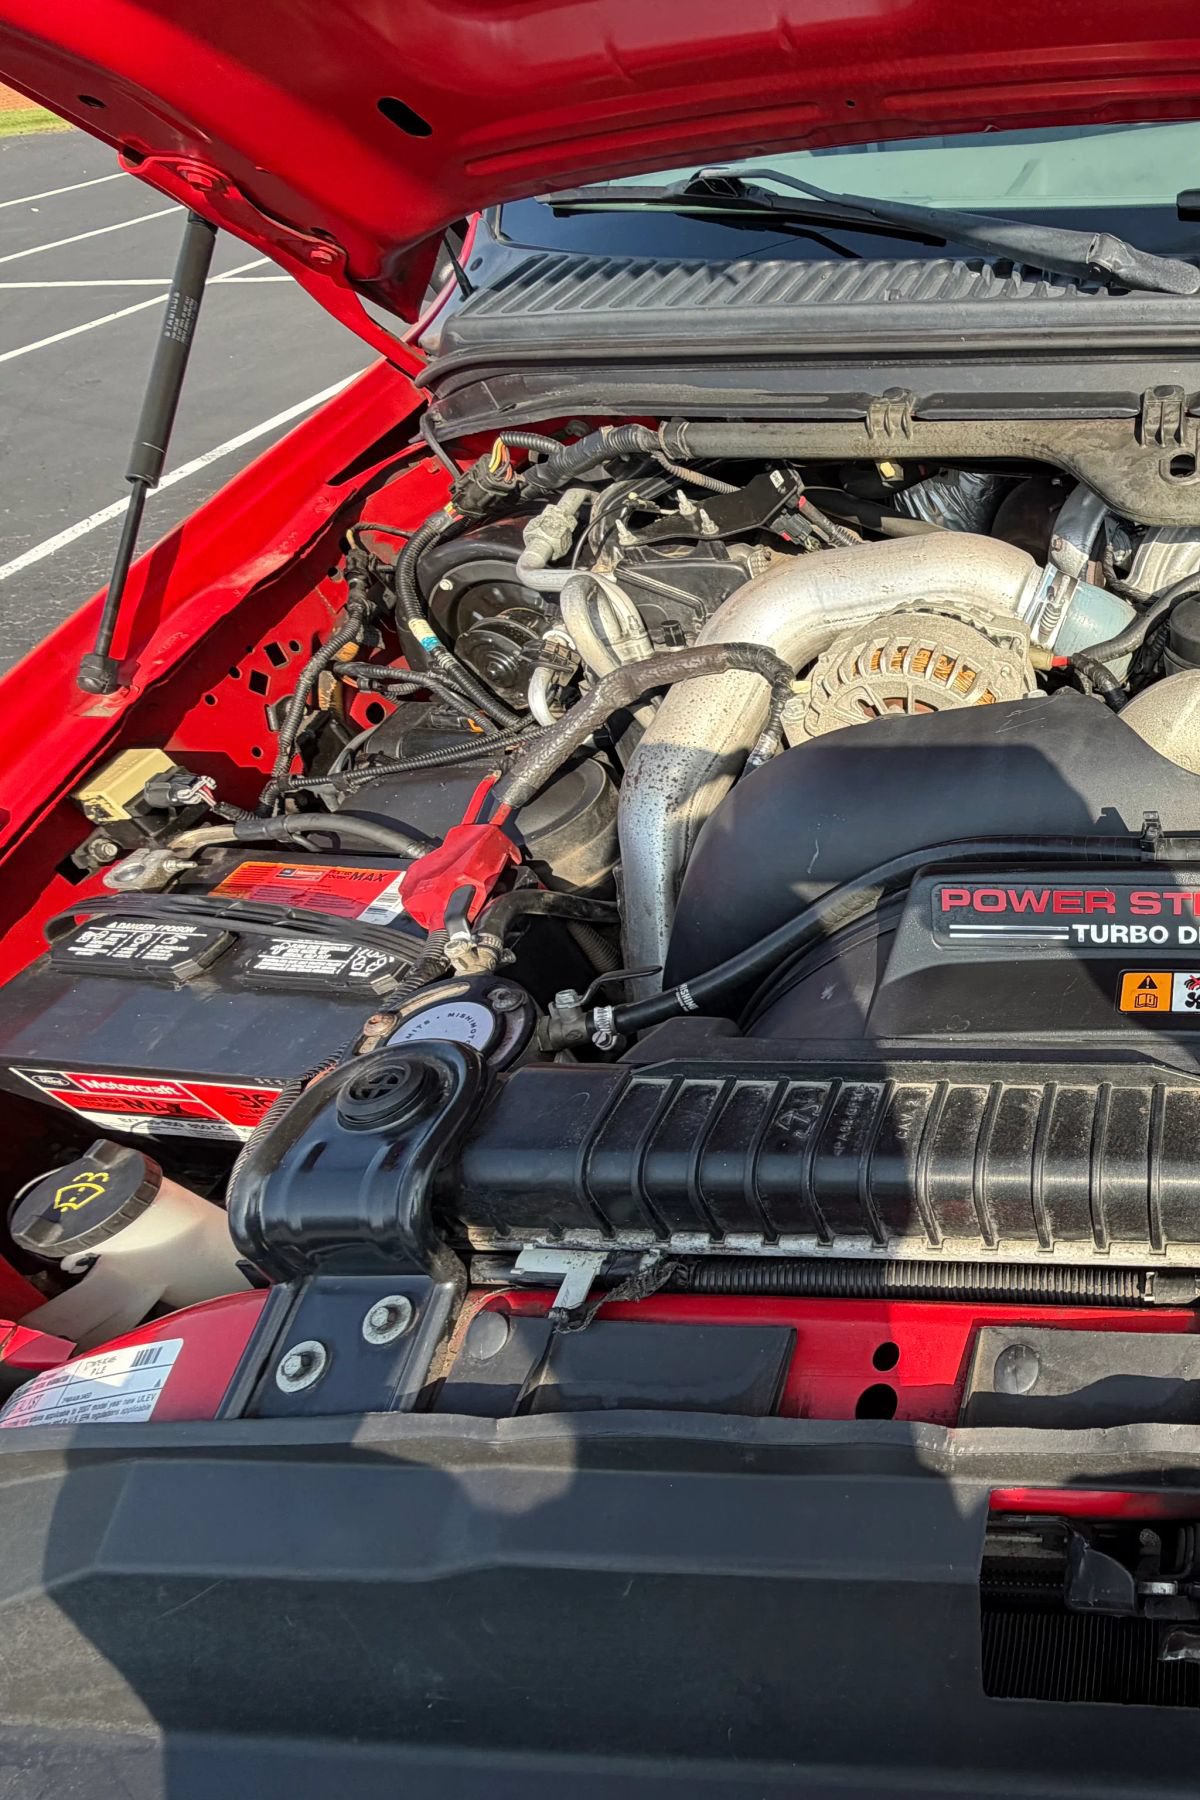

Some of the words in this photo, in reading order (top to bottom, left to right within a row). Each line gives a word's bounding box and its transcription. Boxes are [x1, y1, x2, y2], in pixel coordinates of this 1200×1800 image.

[349, 871, 389, 882] MAX
[941, 888, 1115, 914] POWER
[115, 922, 154, 931] DANGER
[161, 925, 197, 933] POISON
[1071, 924, 1168, 945] TURBO
[80, 1079, 183, 1096] Motorcraft
[121, 1098, 181, 1114] MAX
